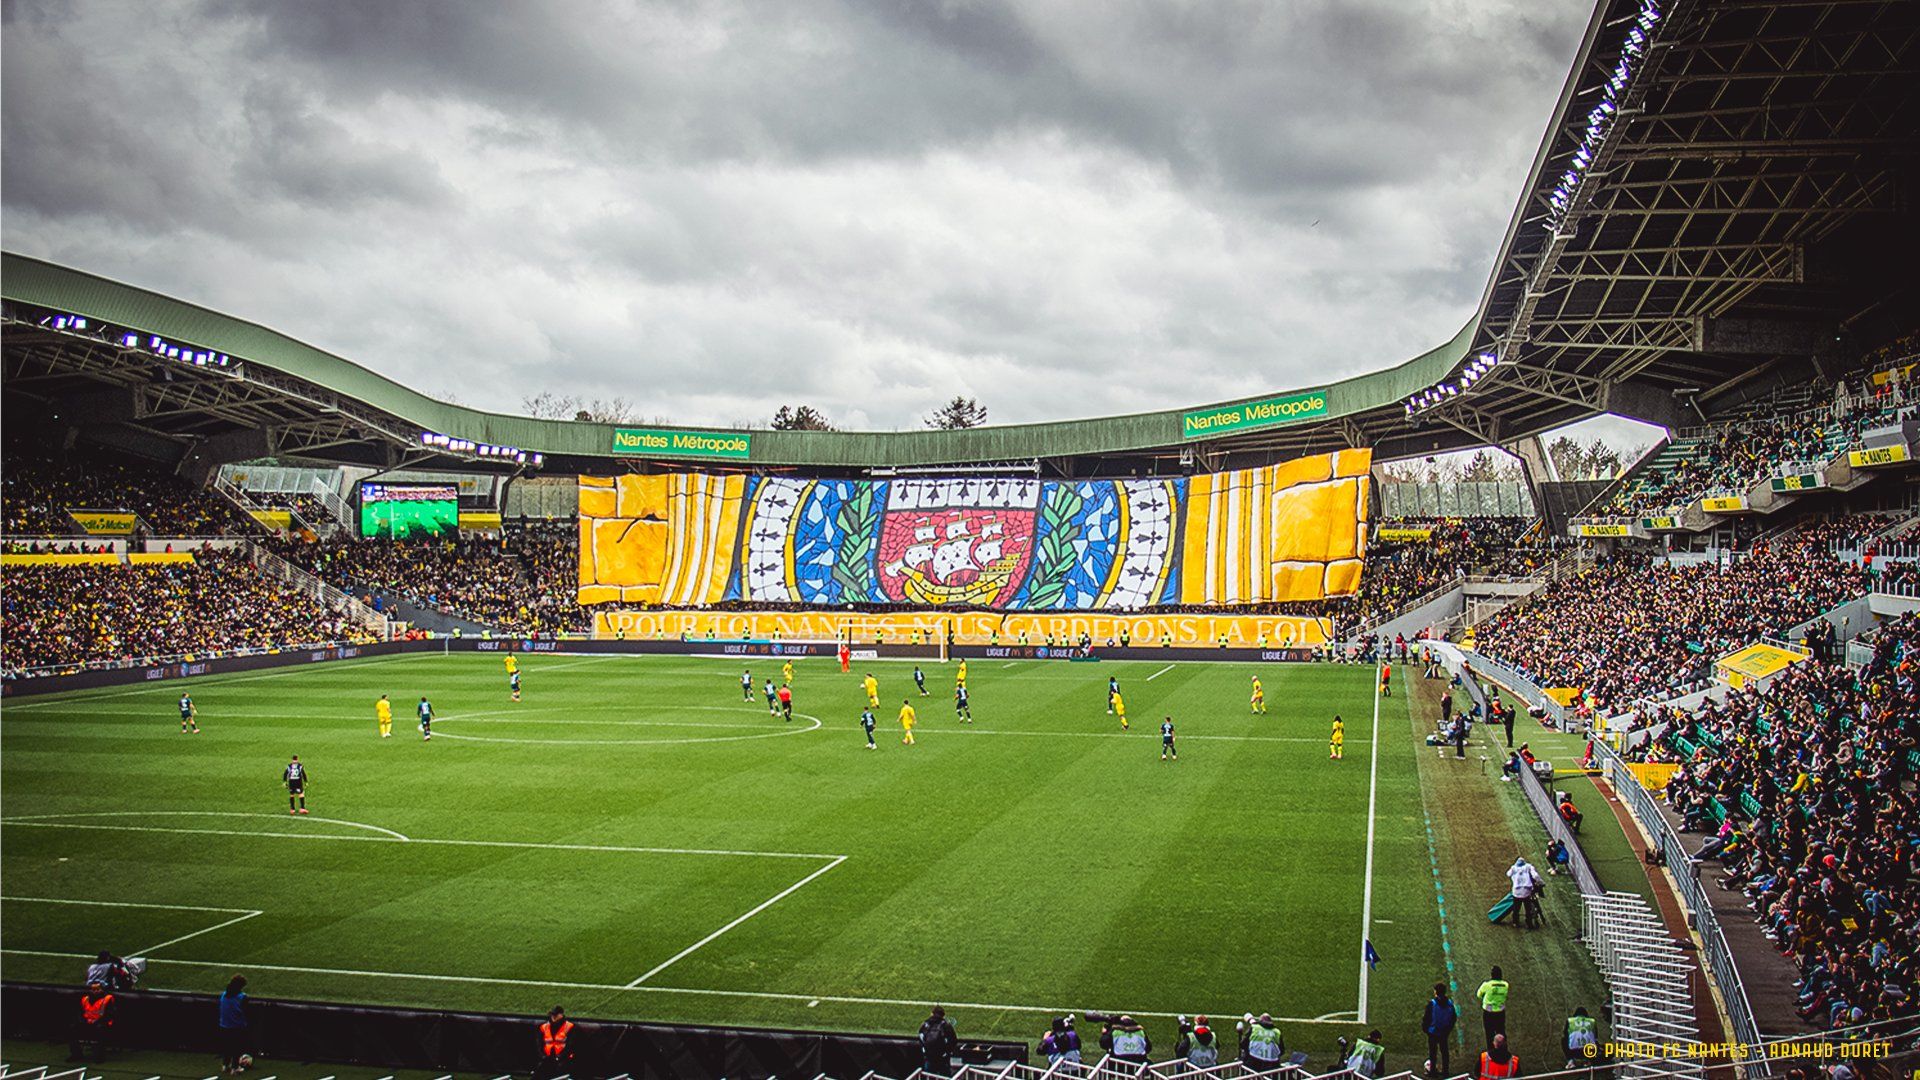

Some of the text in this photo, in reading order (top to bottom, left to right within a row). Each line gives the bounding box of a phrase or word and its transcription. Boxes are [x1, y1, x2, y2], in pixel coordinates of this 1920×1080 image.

[1185, 397, 1324, 430] Nantes Métropole
[615, 432, 748, 453] Nantes Métropole
[617, 614, 701, 640] POUR
[913, 615, 1000, 642] NOUS
[1003, 617, 1197, 644] GARDERONS
